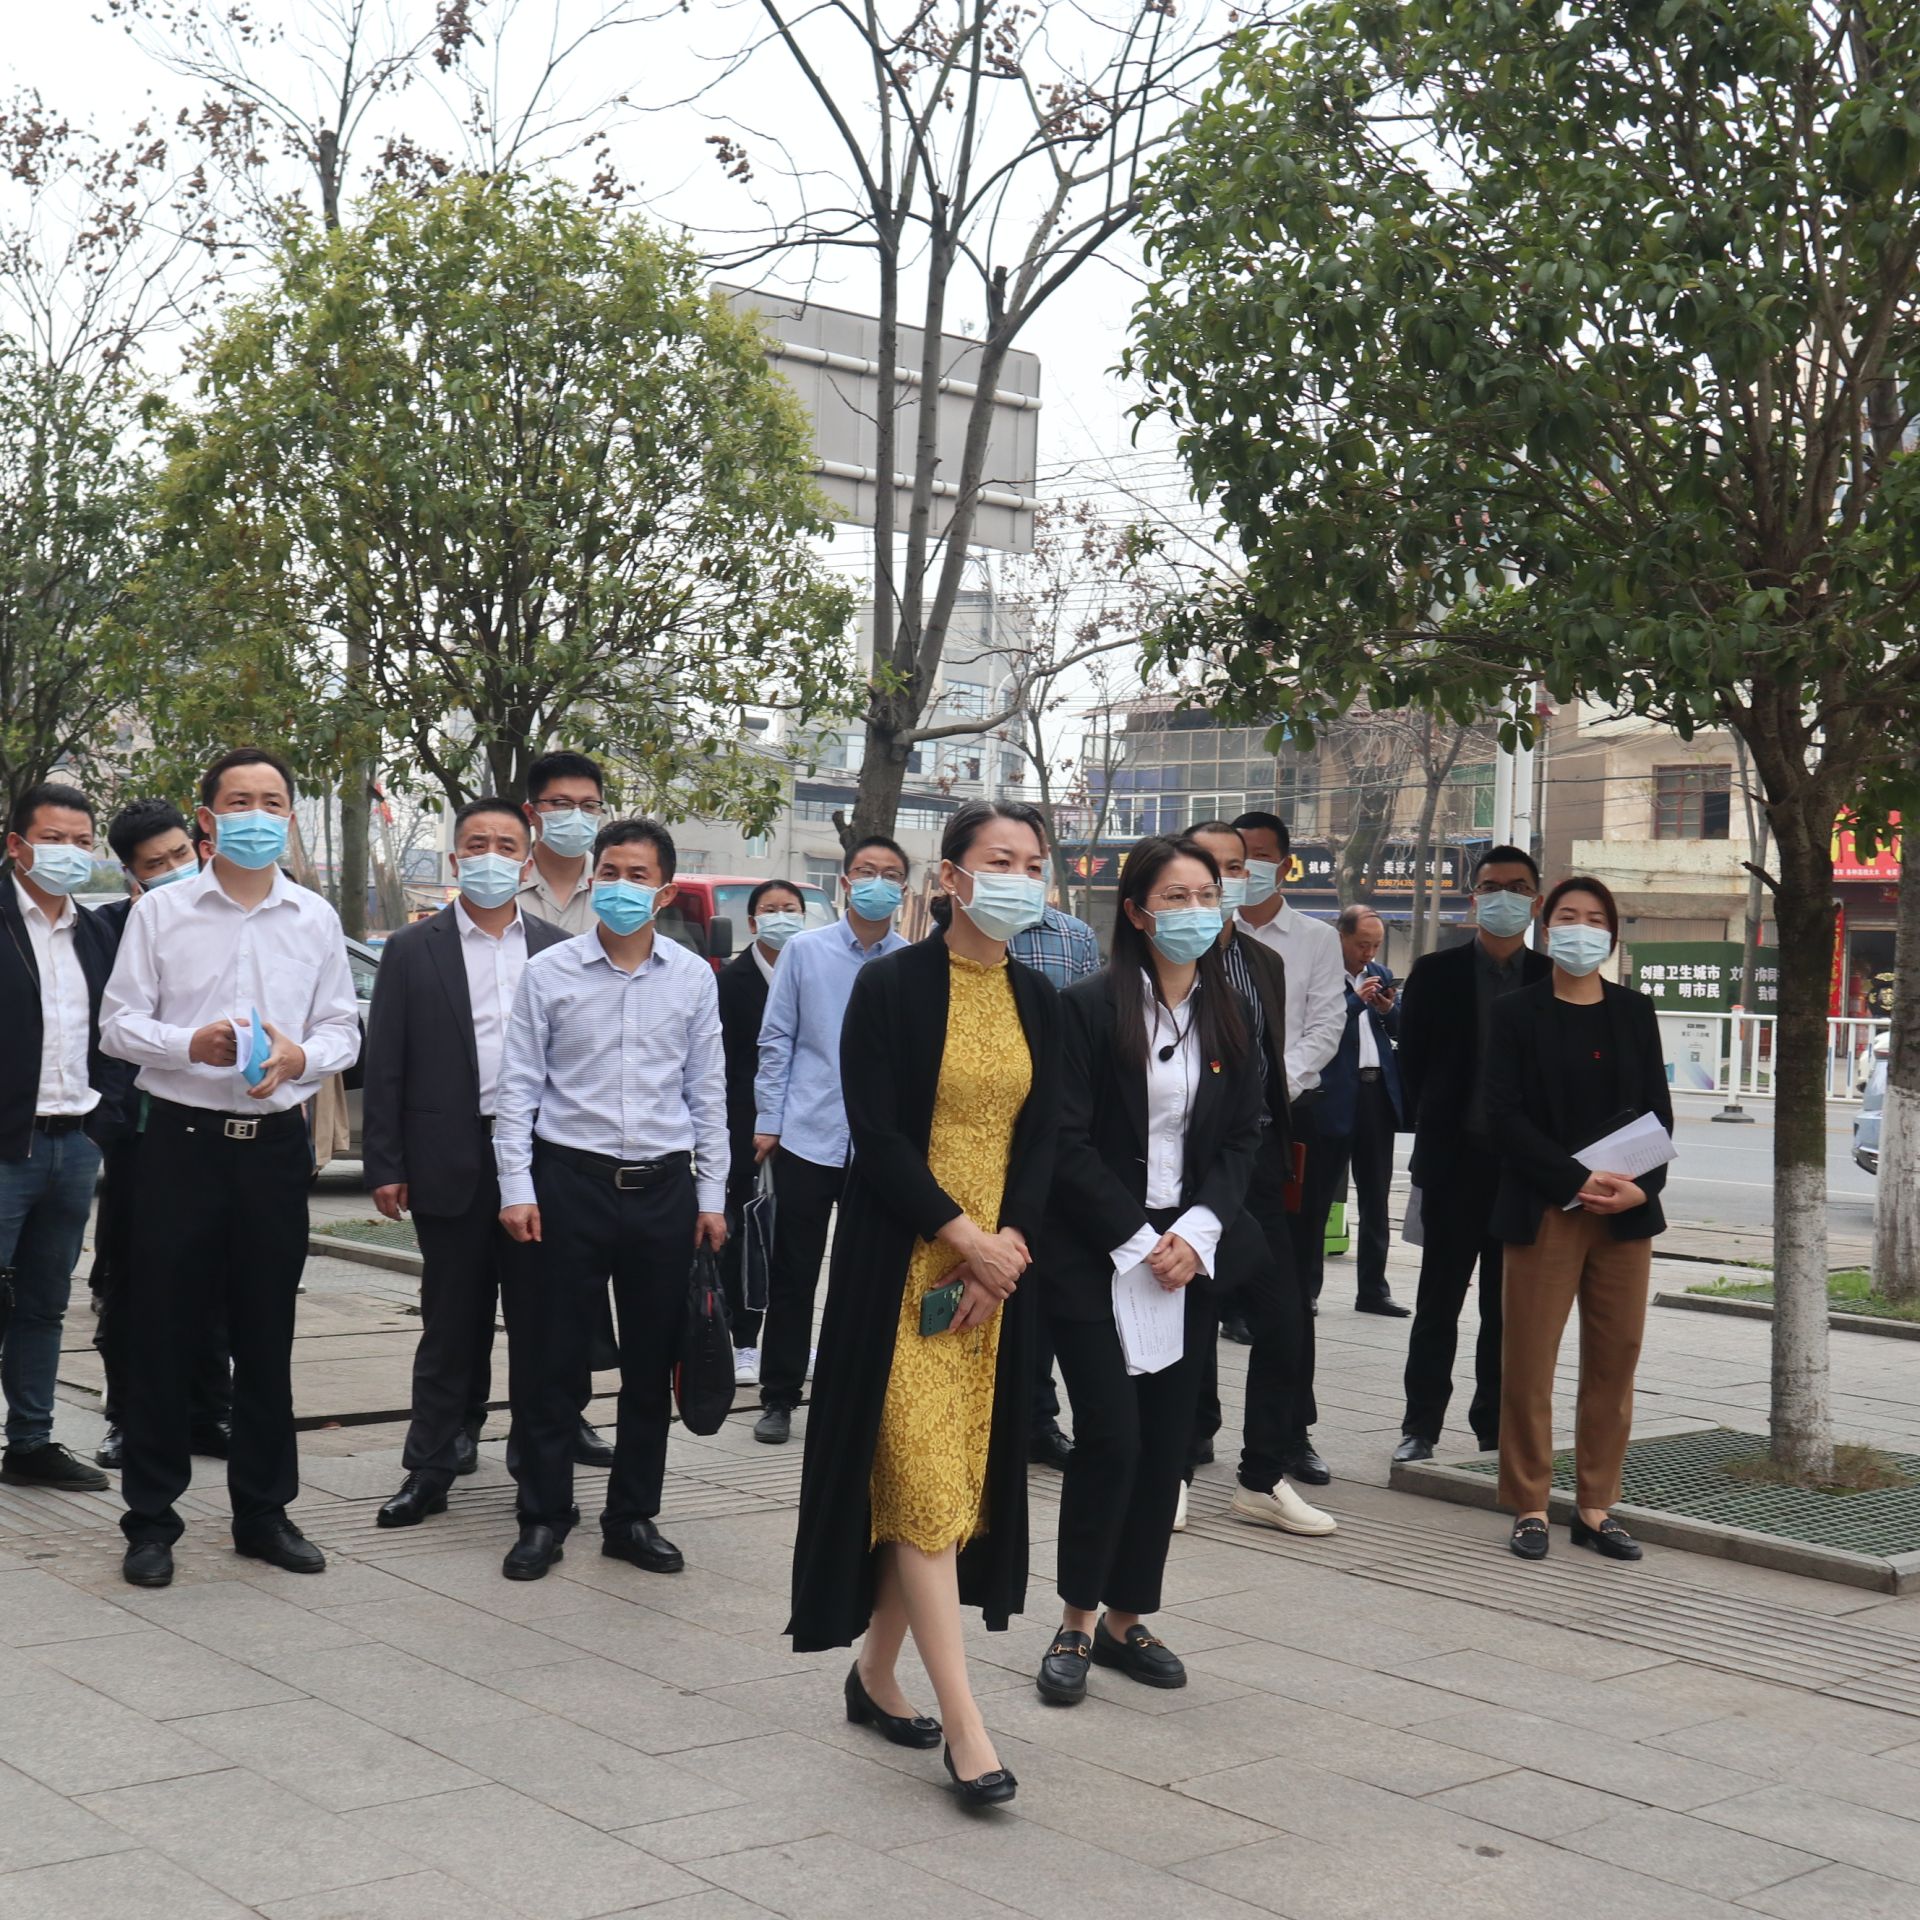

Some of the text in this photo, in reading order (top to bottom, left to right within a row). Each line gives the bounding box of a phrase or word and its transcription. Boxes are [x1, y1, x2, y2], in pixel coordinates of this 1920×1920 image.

[1640, 965, 1720, 980] 创建卫生城市
